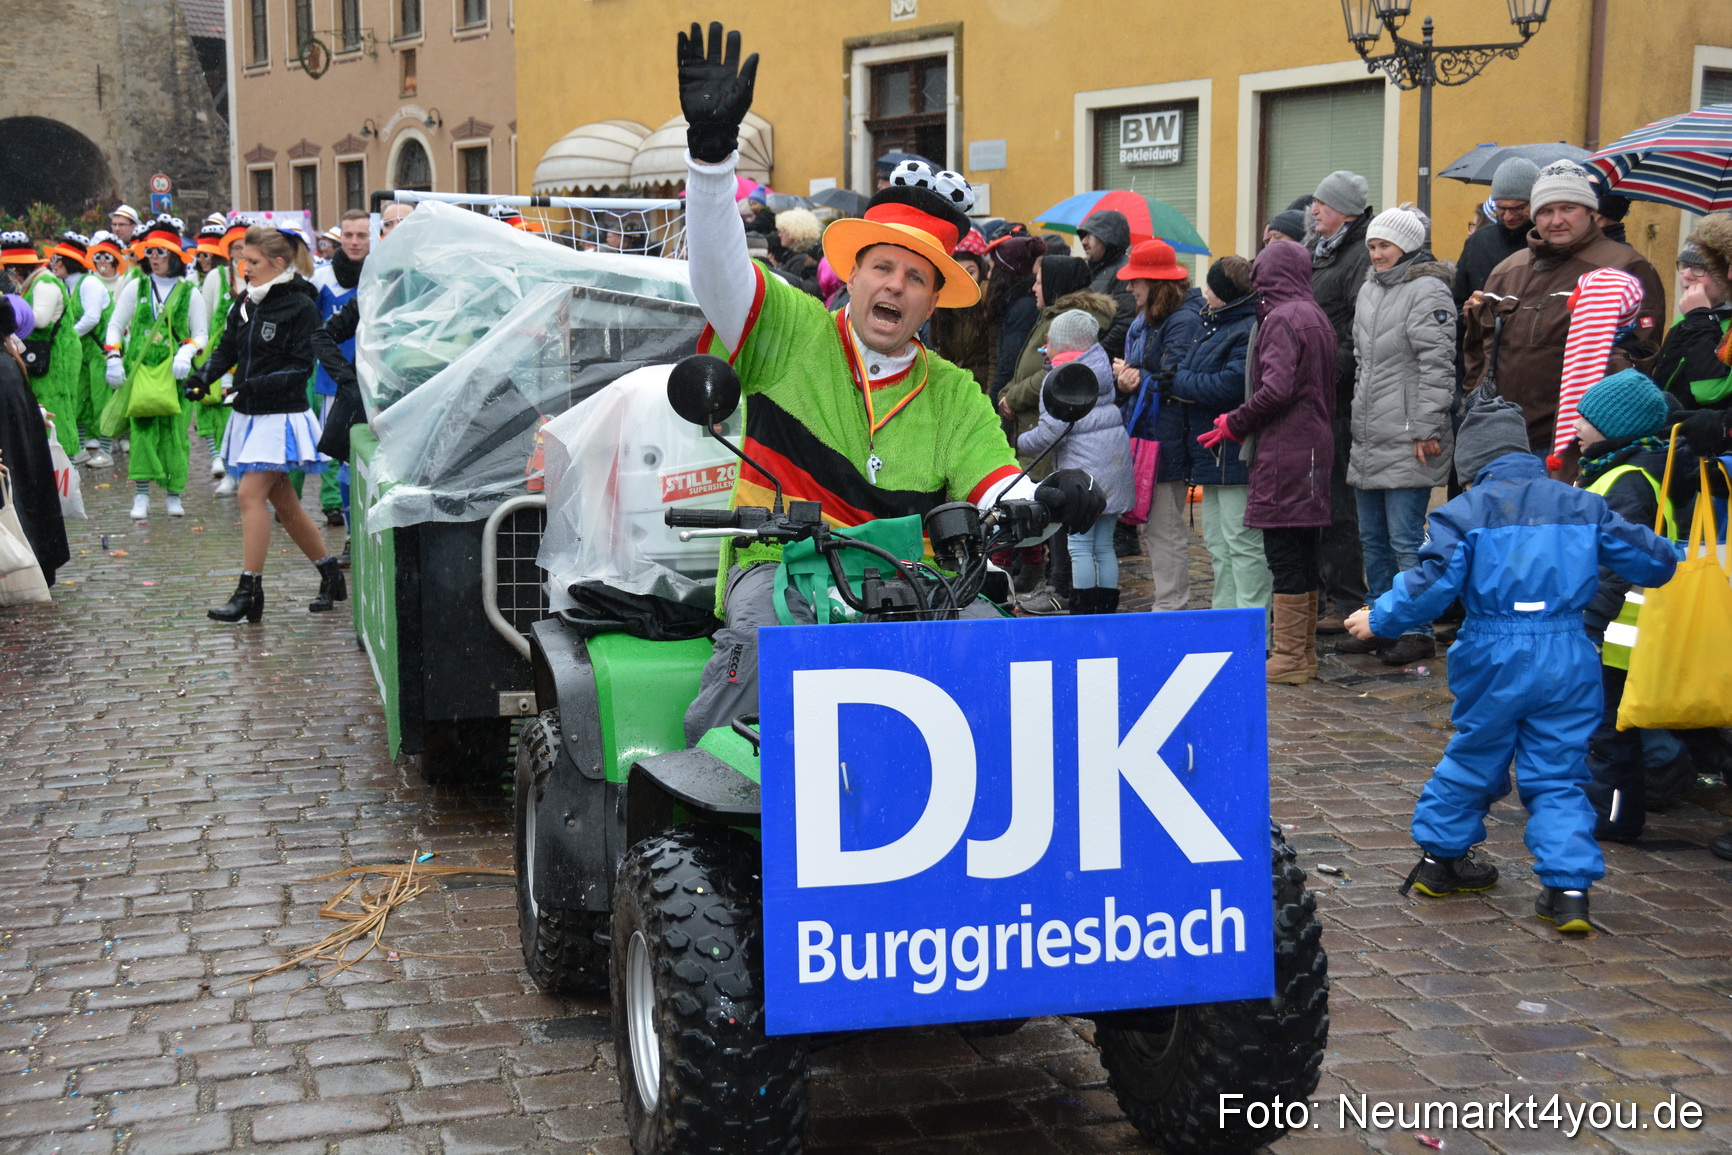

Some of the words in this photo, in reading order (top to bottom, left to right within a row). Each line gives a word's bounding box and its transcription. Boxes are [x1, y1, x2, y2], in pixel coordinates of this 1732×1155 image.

[1123, 115, 1176, 144] BW
[1120, 147, 1179, 163] Bekleidung
[666, 470, 712, 493] STILL
[717, 465, 737, 482] 20
[689, 480, 735, 495] SUPERSILEN
[728, 643, 743, 678] RECCO
[793, 651, 1243, 888] DJK
[797, 889, 1246, 994] Burggriesbach
